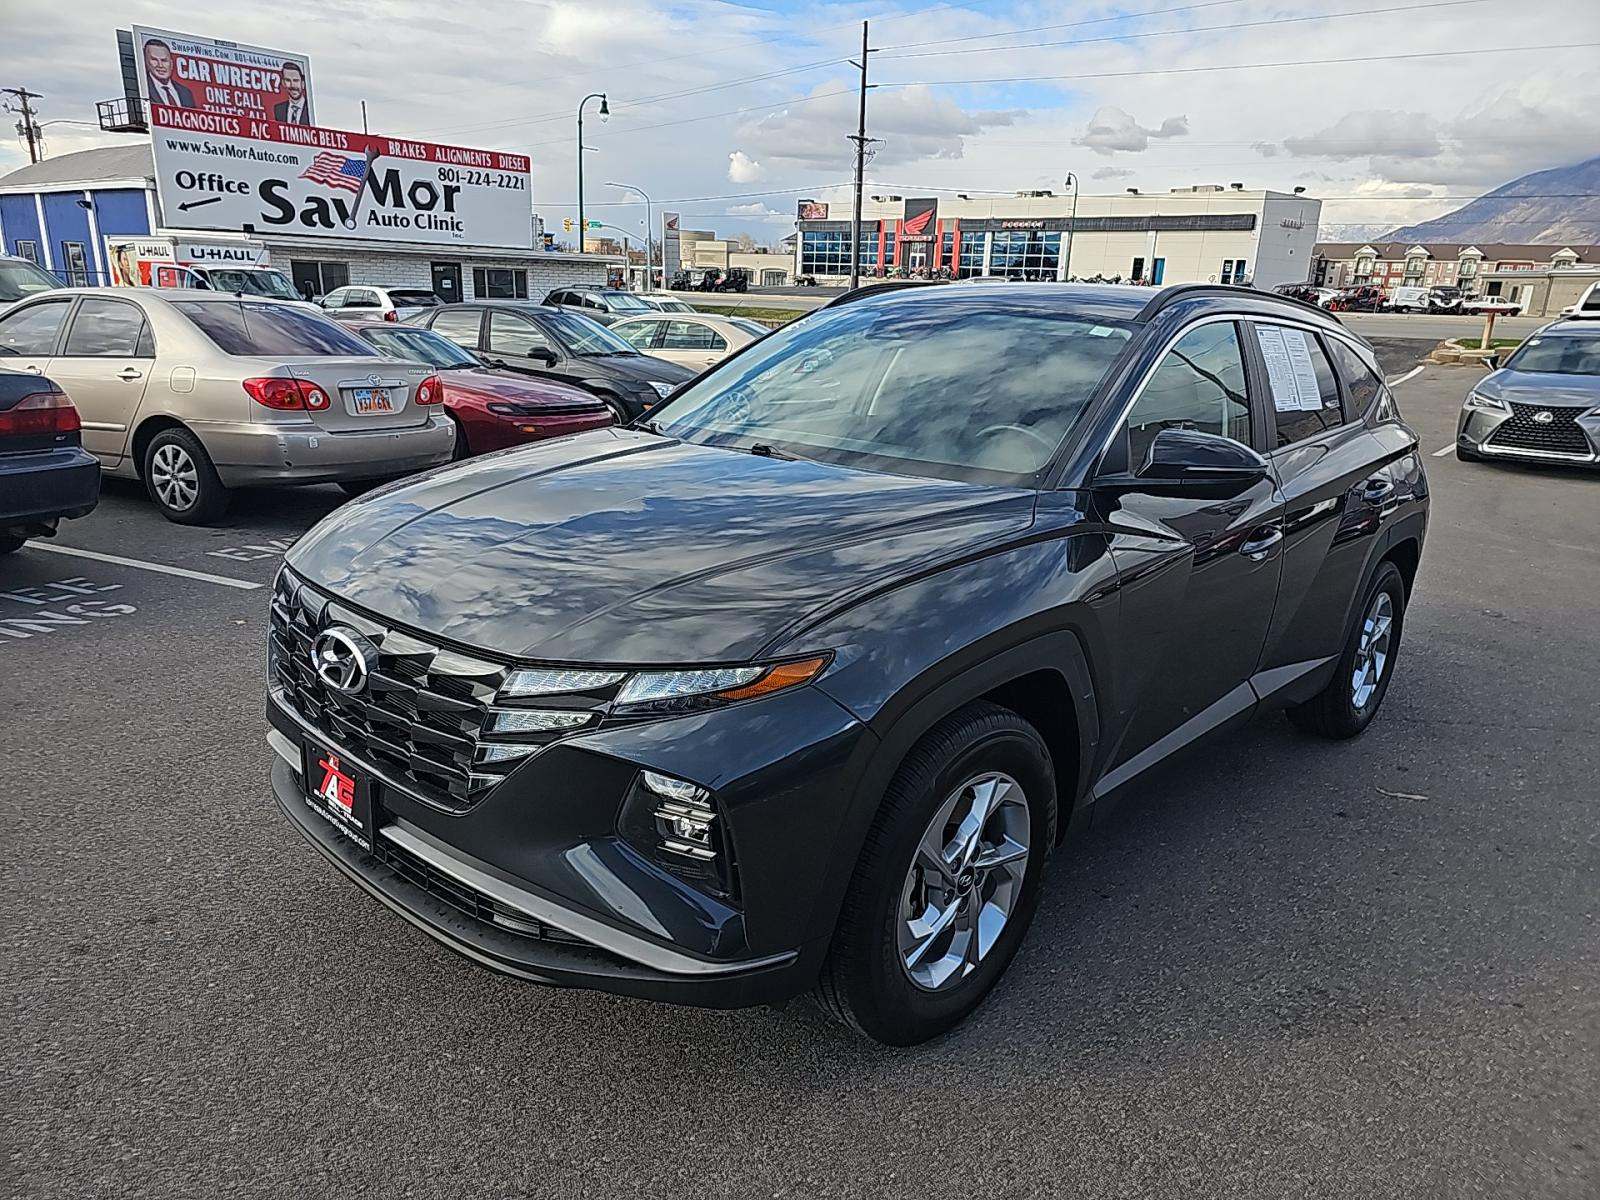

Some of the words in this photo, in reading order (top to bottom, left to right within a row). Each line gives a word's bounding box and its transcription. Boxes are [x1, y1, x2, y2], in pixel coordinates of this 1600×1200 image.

[176, 57, 212, 83] CAR
[214, 66, 281, 93] WRECK?
[205, 86, 231, 105] ONE
[234, 91, 265, 110] CALL
[158, 108, 240, 135] DIAGNOSTICS
[250, 122, 271, 140] A/C
[278, 125, 318, 145] TIMING
[319, 131, 348, 149] BELTS
[388, 140, 427, 160] BRAKES
[435, 147, 492, 167] ALIGNMENTS
[499, 155, 527, 171] DIESEL
[165, 139, 299, 166] www.SavMorAuto.com
[175, 170, 250, 195] Office
[437, 166, 526, 191] 801-224-2221
[258, 178, 357, 230] Sav
[366, 168, 462, 213] Mor
[367, 209, 410, 228] Auto
[414, 213, 464, 232] Clinic
[138, 245, 170, 257] U-HAUL
[190, 247, 256, 262] U-HAUL
